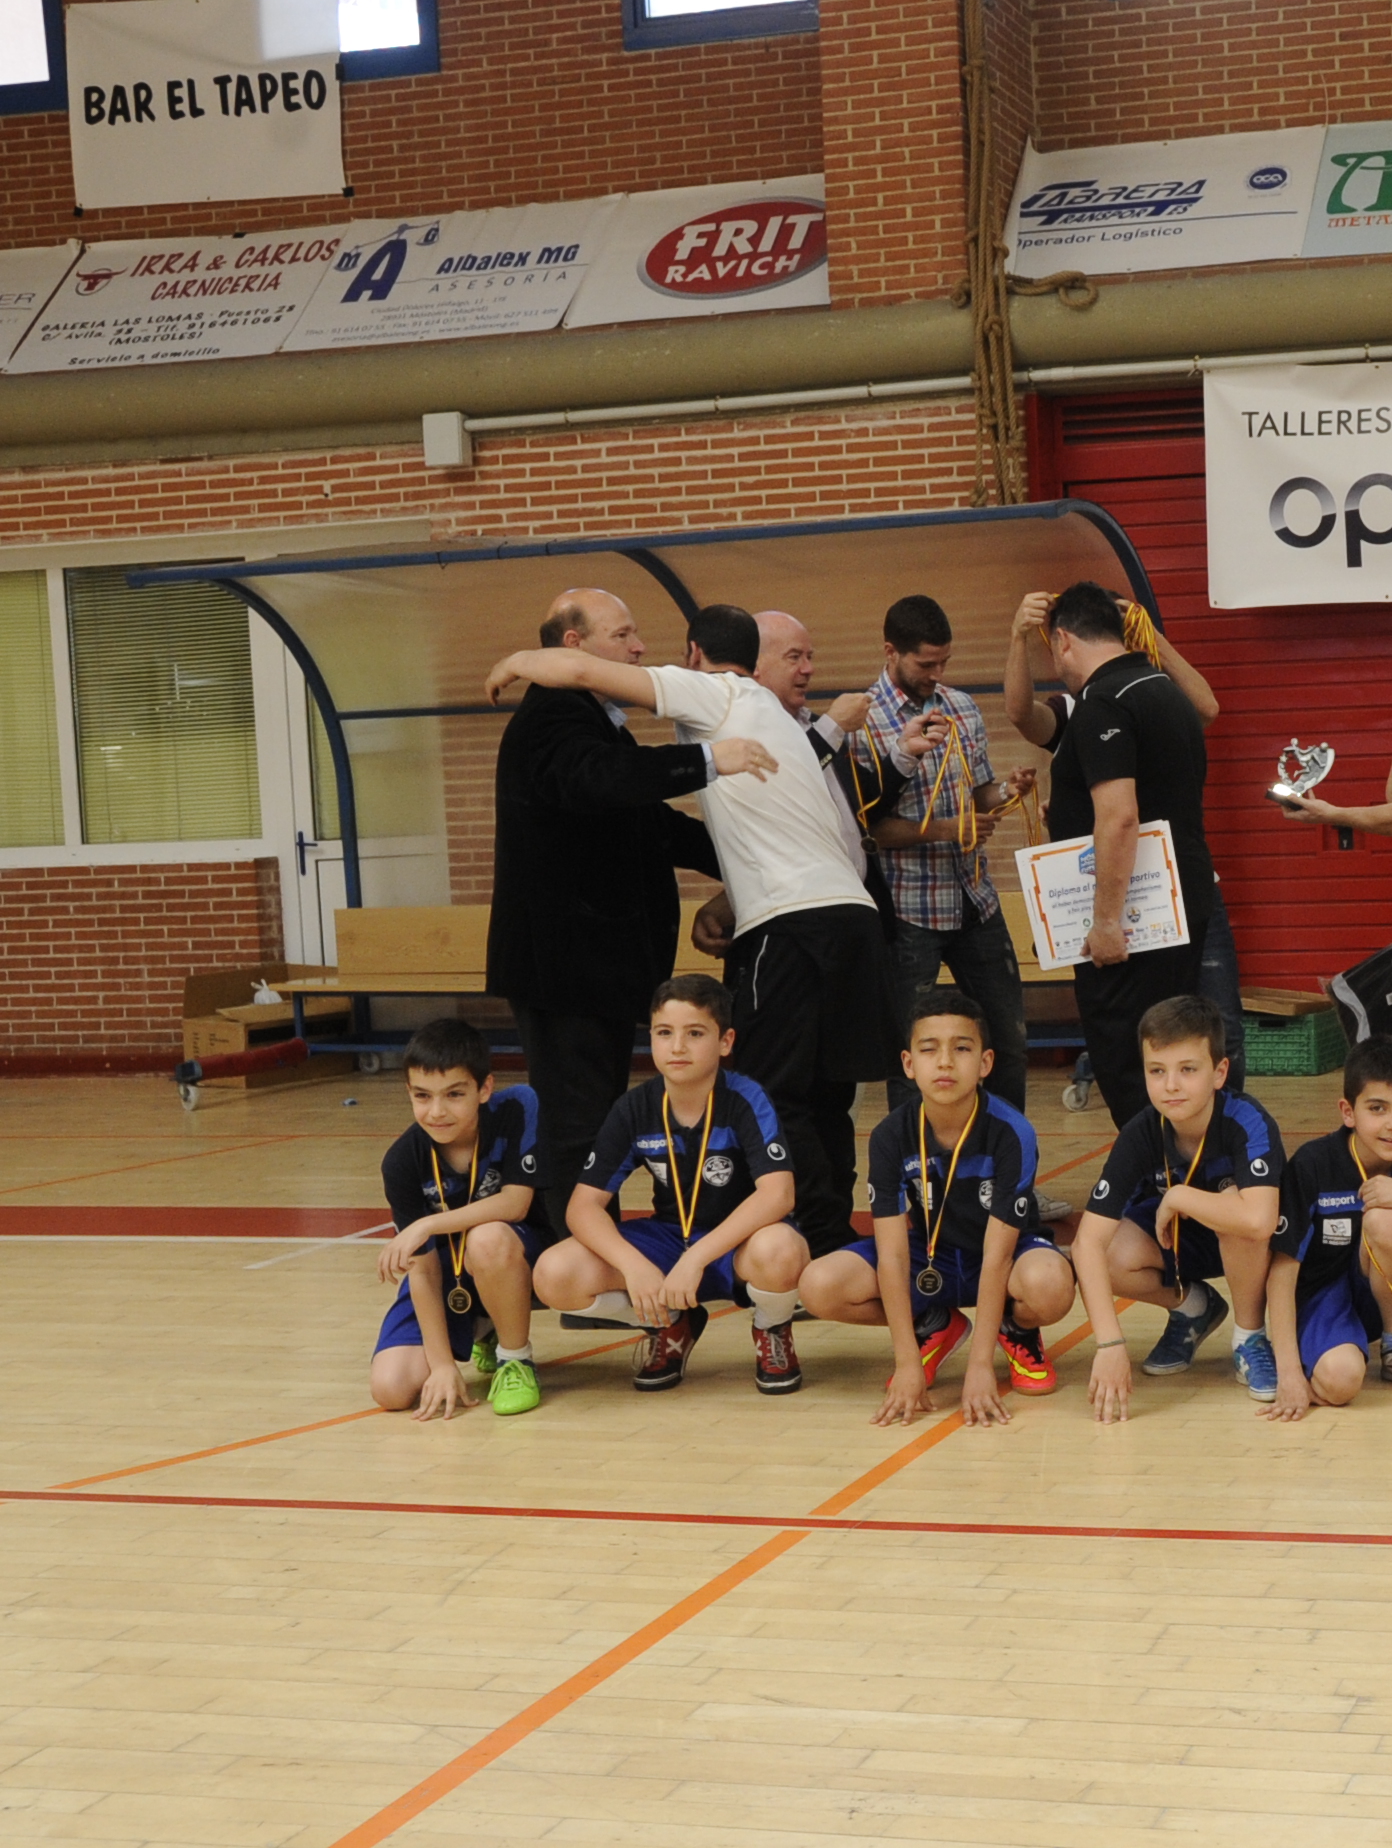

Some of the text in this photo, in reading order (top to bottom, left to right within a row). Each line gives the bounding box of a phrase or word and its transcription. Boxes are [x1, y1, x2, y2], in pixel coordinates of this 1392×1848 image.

[84, 69, 327, 126] BAR EL TAPEO
[1020, 198, 1200, 226] TRANSPORTES
[674, 212, 825, 261] FRIT
[1101, 227, 1184, 242] Logístico
[130, 238, 342, 277] IRRA & CARLOS
[340, 239, 407, 303] A
[436, 244, 581, 275] Albalex MG
[664, 254, 801, 284] RAVICH
[150, 272, 283, 301] CARNICERIA
[112, 317, 141, 328] LAS
[146, 312, 205, 325] LOMAS
[1241, 406, 1392, 438] TALLERES
[1130, 871, 1161, 885] portivo
